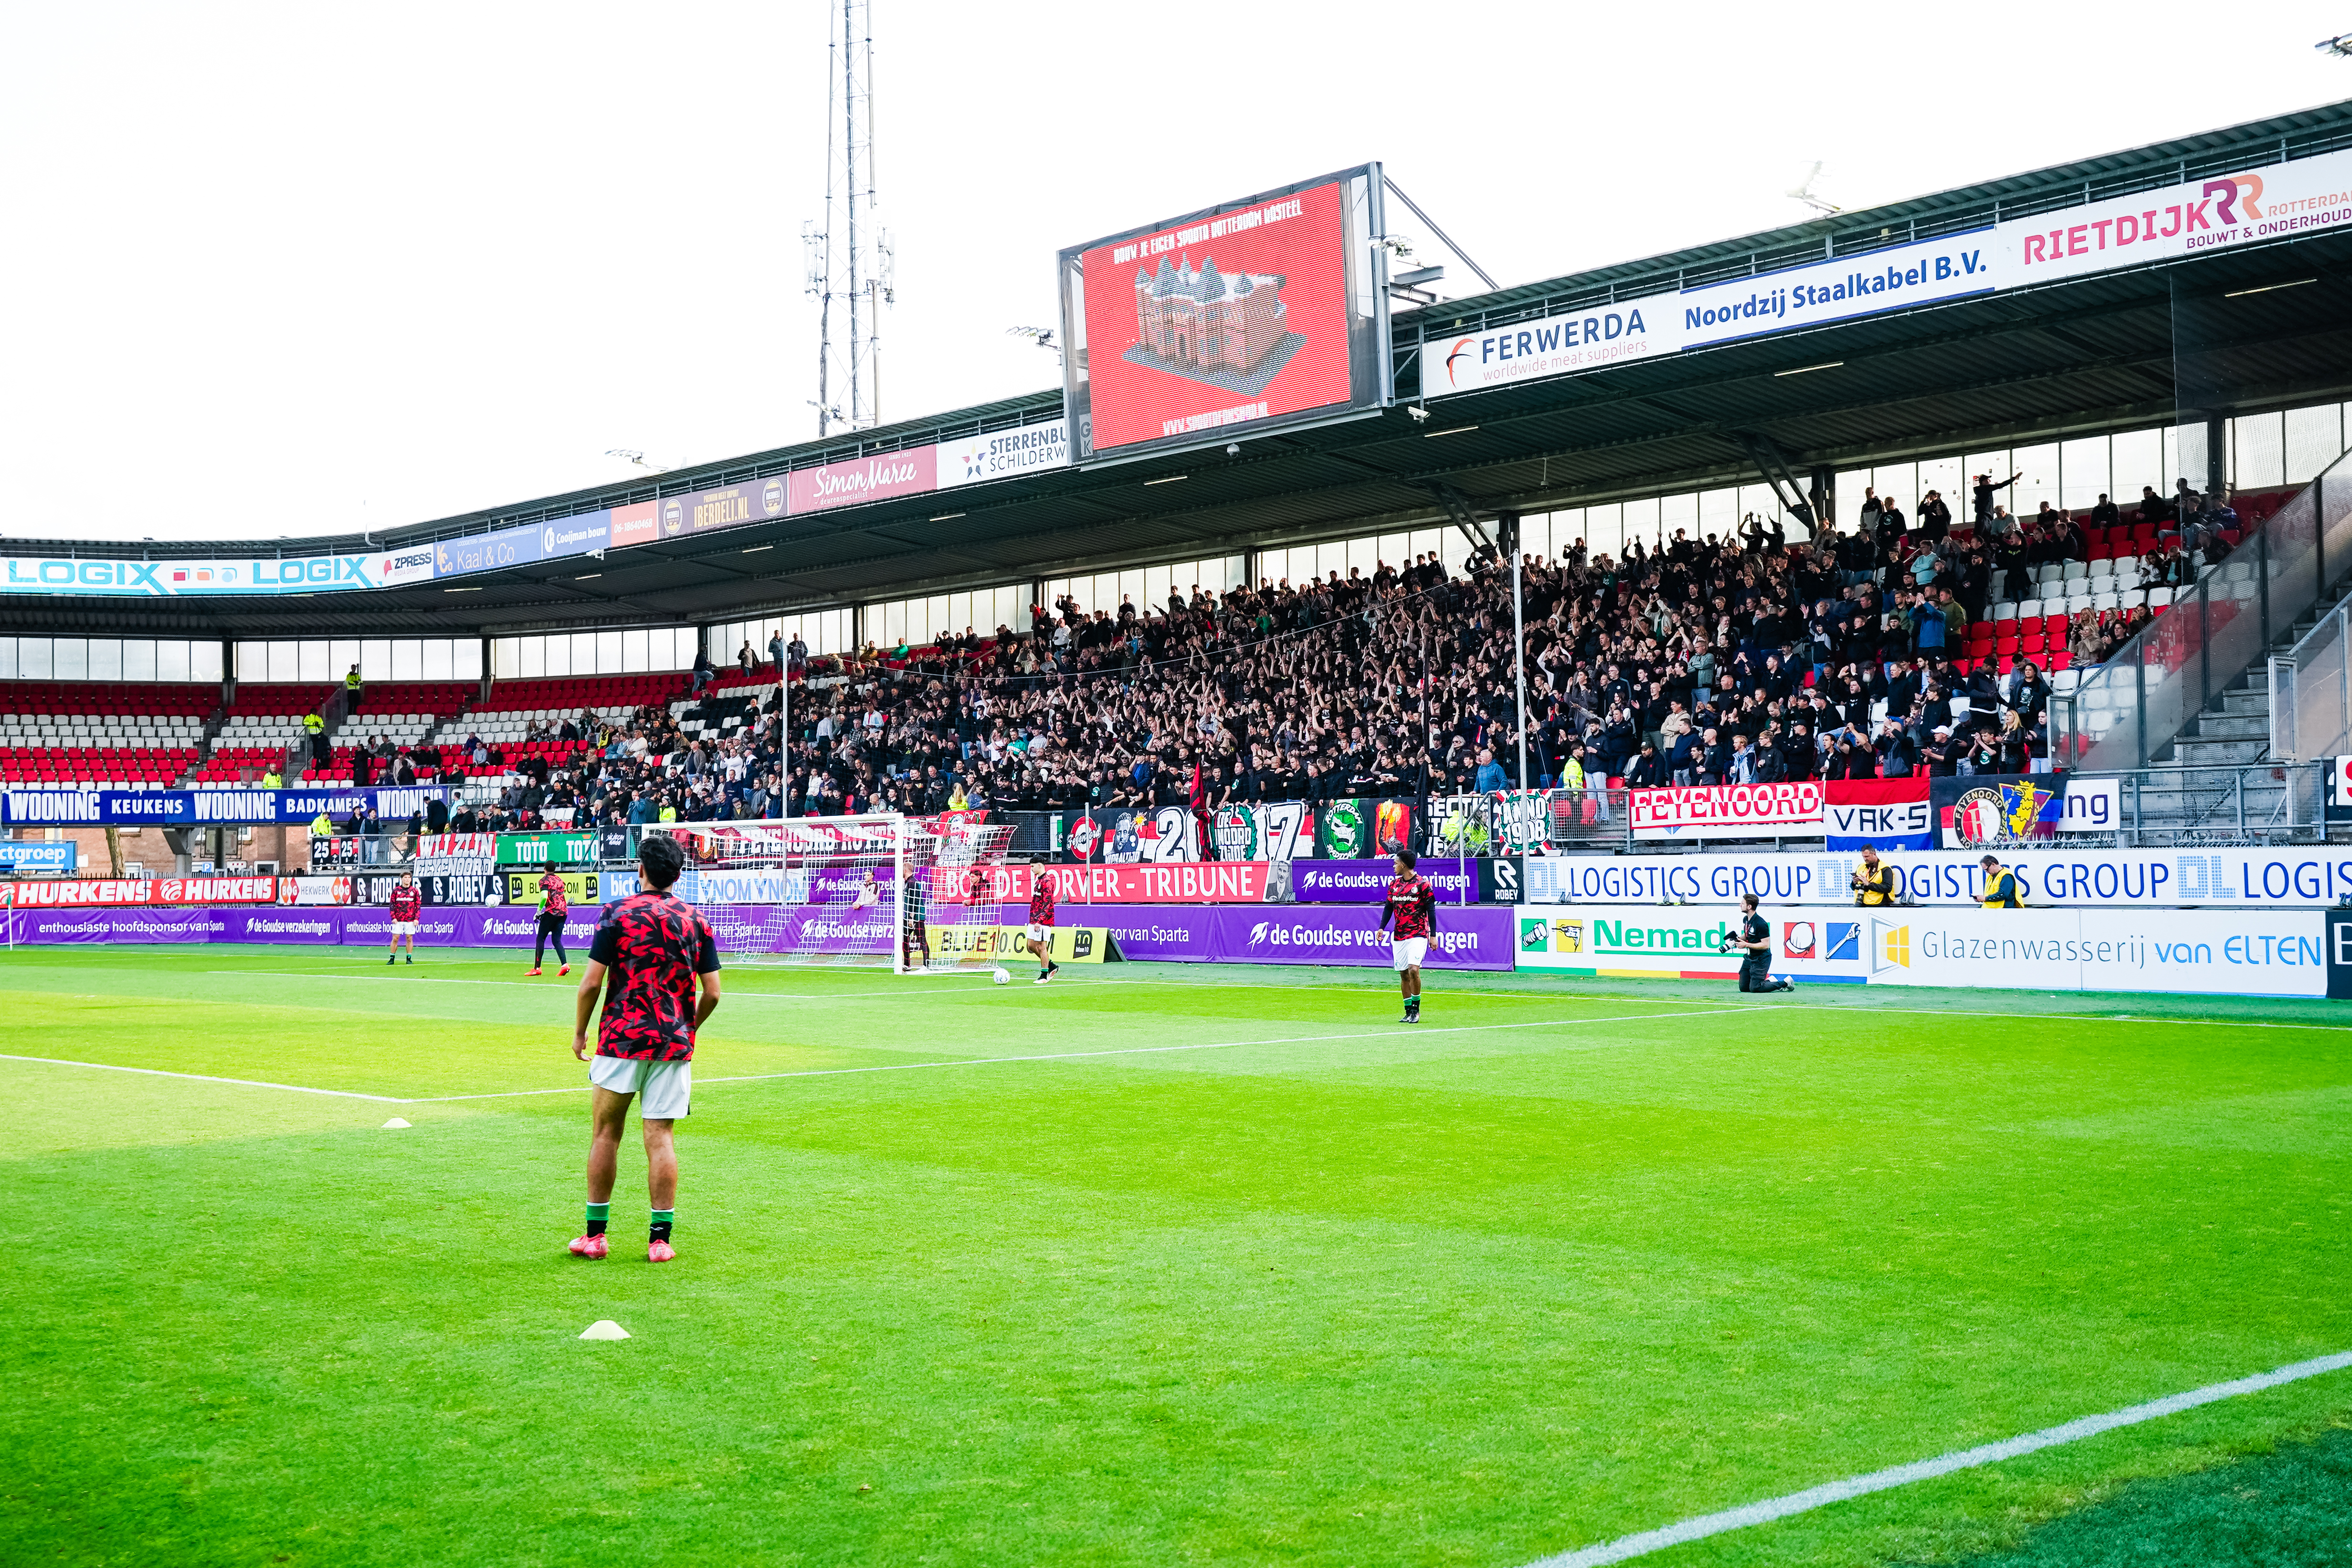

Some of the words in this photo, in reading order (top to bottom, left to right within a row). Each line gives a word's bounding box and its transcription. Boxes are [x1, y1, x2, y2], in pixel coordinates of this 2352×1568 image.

[2268, 189, 2352, 217] ROTTERDA
[2025, 198, 2210, 265] RIETDIJK
[2187, 230, 2237, 248] BOUWT
[2243, 227, 2254, 238] &
[1686, 287, 1785, 329] Noordzij
[1793, 260, 1927, 309] Staalkabel
[1935, 248, 1987, 282] B.V.
[1482, 308, 1646, 365] FERWERDA
[1483, 357, 1548, 382] worldwide
[1551, 354, 1585, 371] meat
[1588, 338, 1647, 367] suppliers
[990, 421, 1091, 455] STERRENBUG
[888, 453, 901, 461] SINDS
[990, 440, 1092, 472] SCHILDERWK
[813, 467, 867, 497] Simon
[863, 460, 917, 492] Maree
[820, 491, 868, 505] deurenspecialist
[694, 496, 750, 528] IBERDELI.NL
[556, 529, 587, 547] Cooijman
[588, 526, 607, 541] bouw
[614, 518, 653, 534] 06-18640468
[394, 552, 432, 569] ZPRESS
[457, 547, 482, 570] Kaal
[485, 546, 495, 567] &
[498, 543, 515, 564] Co
[9, 561, 167, 593] LOGIX
[253, 557, 372, 587] LOGIX
[406, 567, 420, 575] GROUP
[9, 792, 100, 821] WOONING
[111, 799, 183, 814] KEUKENS
[194, 792, 276, 820] WOONING
[1633, 782, 1819, 822] FEYENOORD
[1956, 790, 2003, 819] FEYENOORD
[1325, 803, 1363, 824] ROTTERDAM
[419, 834, 451, 859] WIJ
[452, 832, 495, 858] ZIJN
[1067, 823, 1101, 851] Feyenord
[1215, 827, 1252, 845] NOORD
[0, 845, 66, 864] ctgroep
[314, 841, 329, 858] 25
[341, 841, 353, 857] 25
[516, 842, 548, 862] TOTO
[566, 839, 598, 861] TOTO
[185, 877, 272, 901] HURKENS
[301, 885, 330, 895] HEKWERK
[449, 876, 486, 903] ROBEY
[611, 874, 642, 897] bicto
[837, 878, 863, 891] Gouds
[1140, 867, 1254, 897] TRIBUNE
[1318, 872, 1333, 888] de
[1334, 872, 1379, 888] Goudse
[1571, 866, 1700, 897] LOGISTICS
[1711, 866, 1812, 897] GROUP
[1891, 864, 2030, 898] OGISTS
[2044, 863, 2169, 898] GROUP
[17, 881, 152, 905] HURKENS
[1495, 889, 1519, 900] ROBEY
[39, 921, 109, 933] enthousiaste
[112, 920, 188, 936] hoofdsponsor
[189, 923, 209, 932] van
[209, 920, 224, 932] Sparta
[254, 919, 262, 933] de
[262, 918, 285, 933] Goudse
[285, 917, 330, 937] verzekeringen
[346, 921, 382, 933] enthousiaste
[422, 924, 432, 933] van
[433, 921, 454, 936] Sparta
[493, 919, 503, 935] de
[504, 917, 534, 935] Goudse
[734, 923, 761, 938] Sparta
[830, 920, 871, 938] Goudse
[1128, 927, 1149, 941] van
[1151, 925, 1190, 946] Sparta
[1270, 924, 1289, 946] de
[1292, 924, 1353, 946] Goudse
[1593, 920, 1770, 949] Nemad
[941, 931, 1055, 954] BLUE10.CM
[1076, 934, 1090, 945] 10
[1922, 931, 2144, 968] Glazenwasserij
[2154, 943, 2212, 963] van
[2224, 935, 2320, 966] ELTEN
